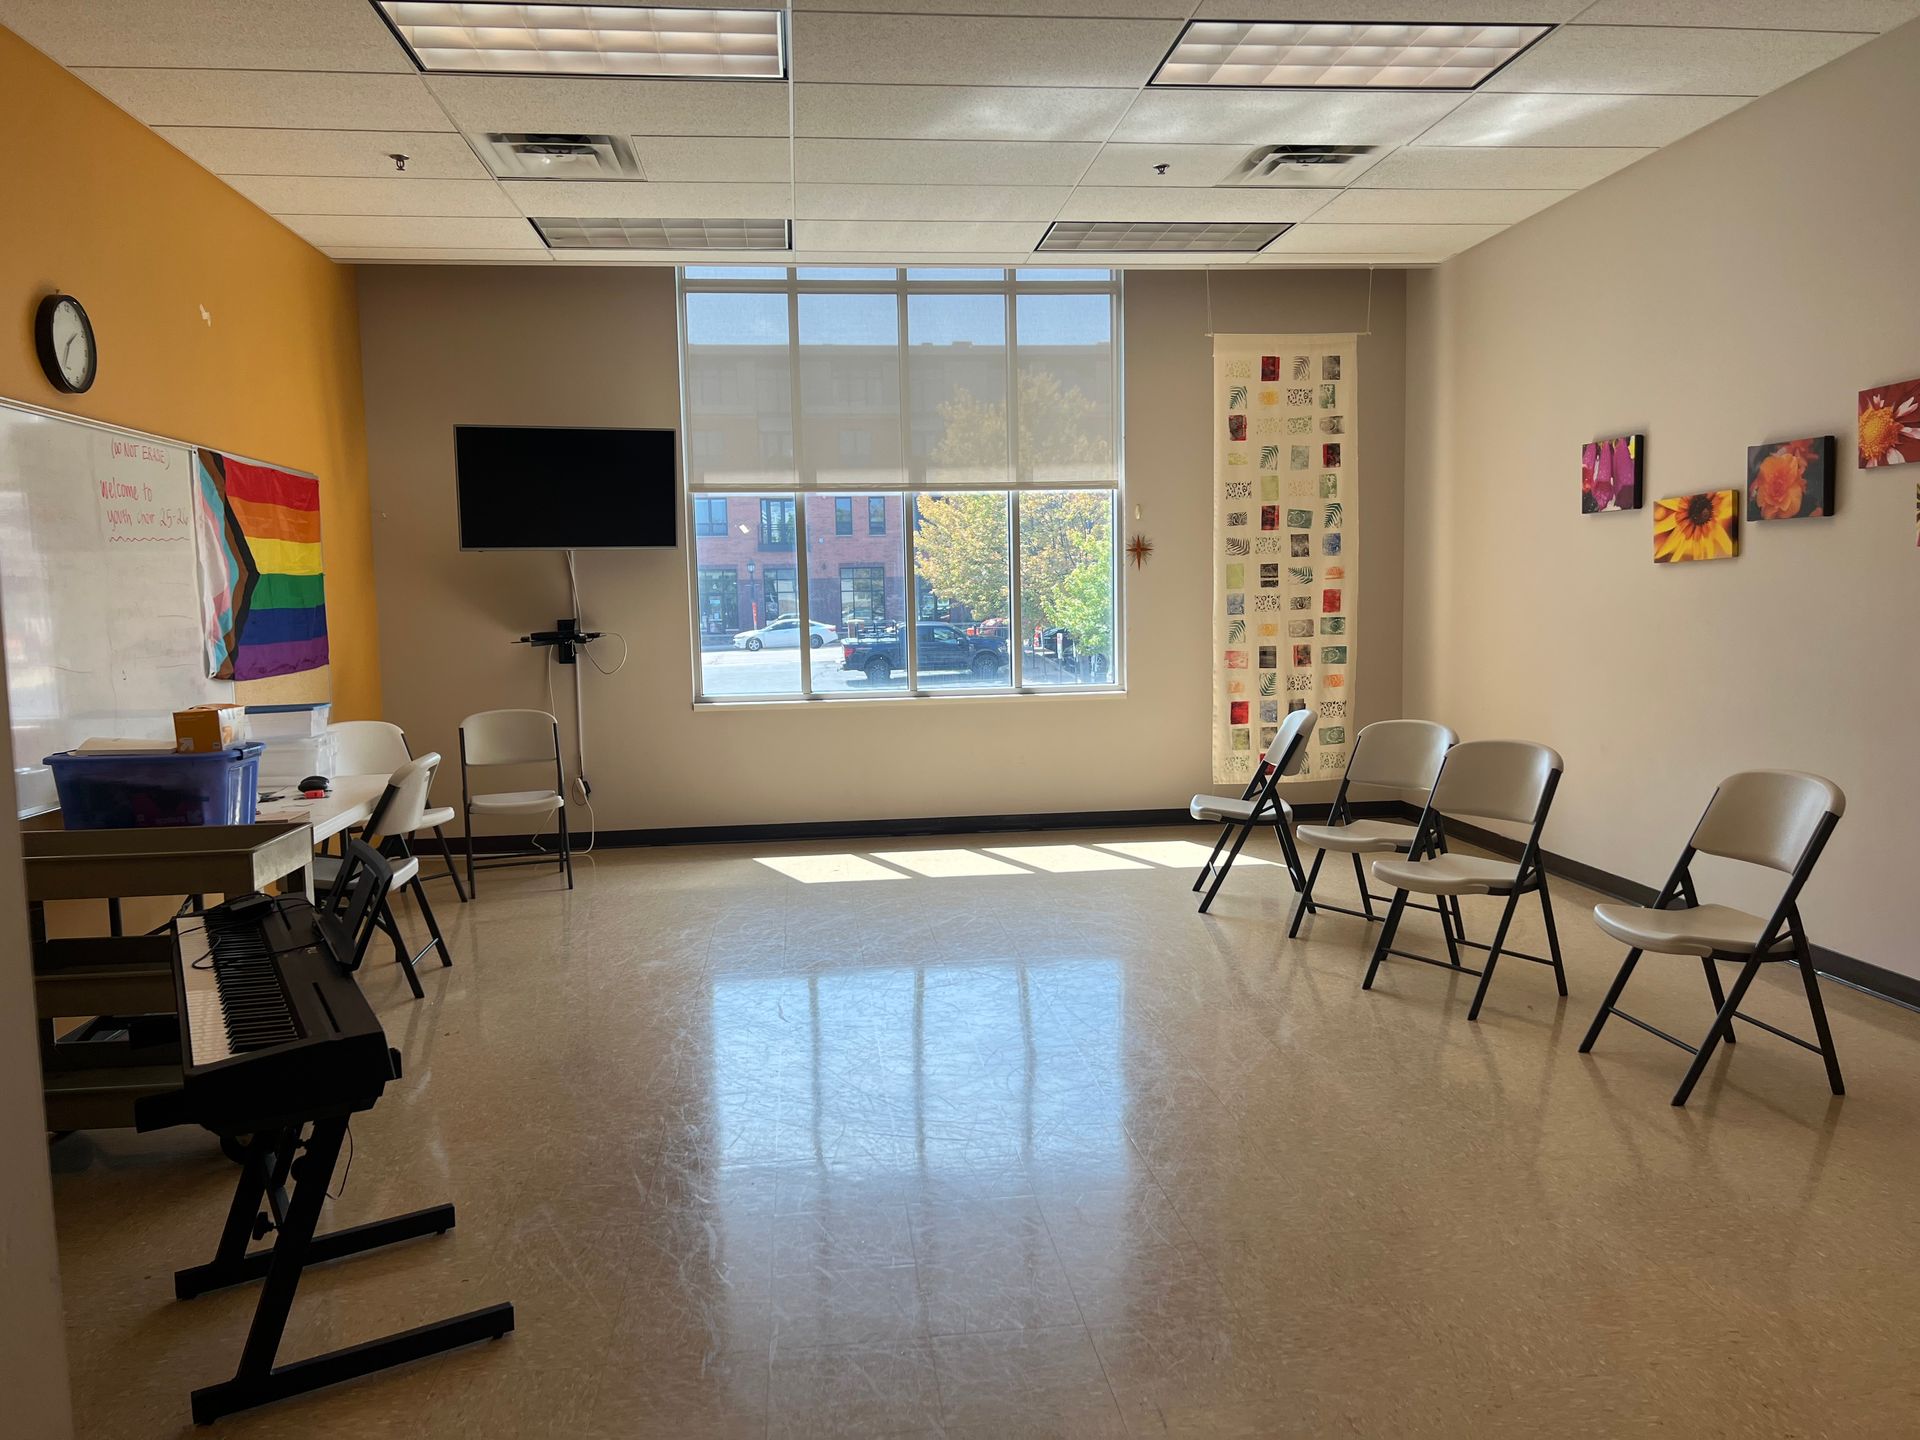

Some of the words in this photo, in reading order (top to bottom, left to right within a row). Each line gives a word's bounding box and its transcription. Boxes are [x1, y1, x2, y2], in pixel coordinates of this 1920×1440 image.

[123, 442, 140, 458] NOT
[142, 482, 153, 502] to
[106, 508, 133, 532] youth
